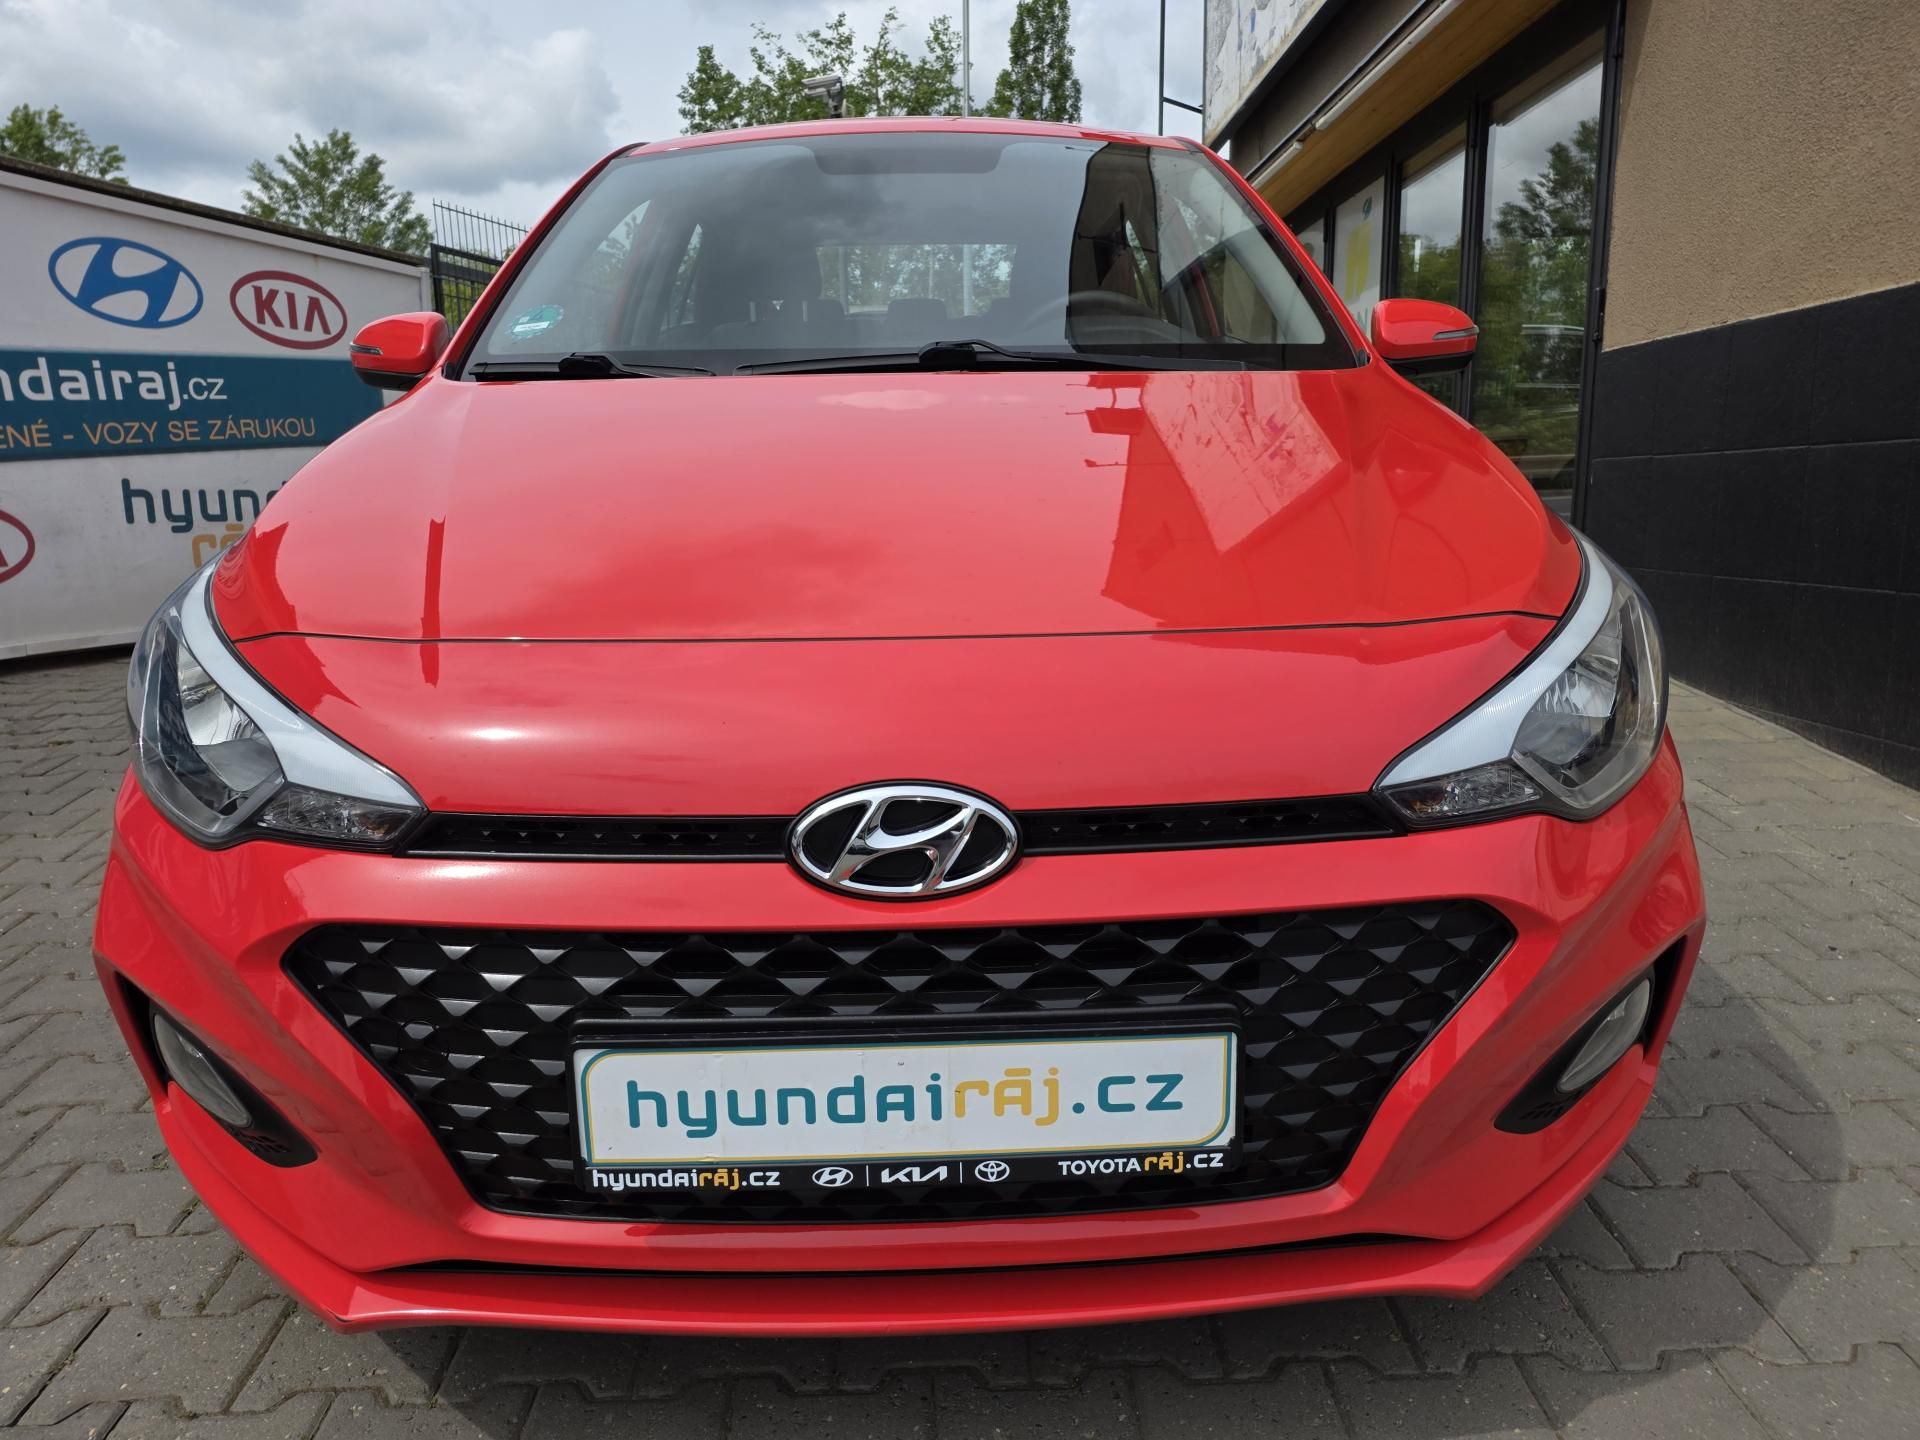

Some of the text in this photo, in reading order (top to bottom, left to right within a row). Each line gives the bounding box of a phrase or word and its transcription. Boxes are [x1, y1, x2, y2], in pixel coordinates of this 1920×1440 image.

[252, 285, 332, 335] KIA
[83, 420, 159, 446] VOZY
[168, 419, 201, 442] SE
[209, 414, 316, 441] ZÁRUKOU
